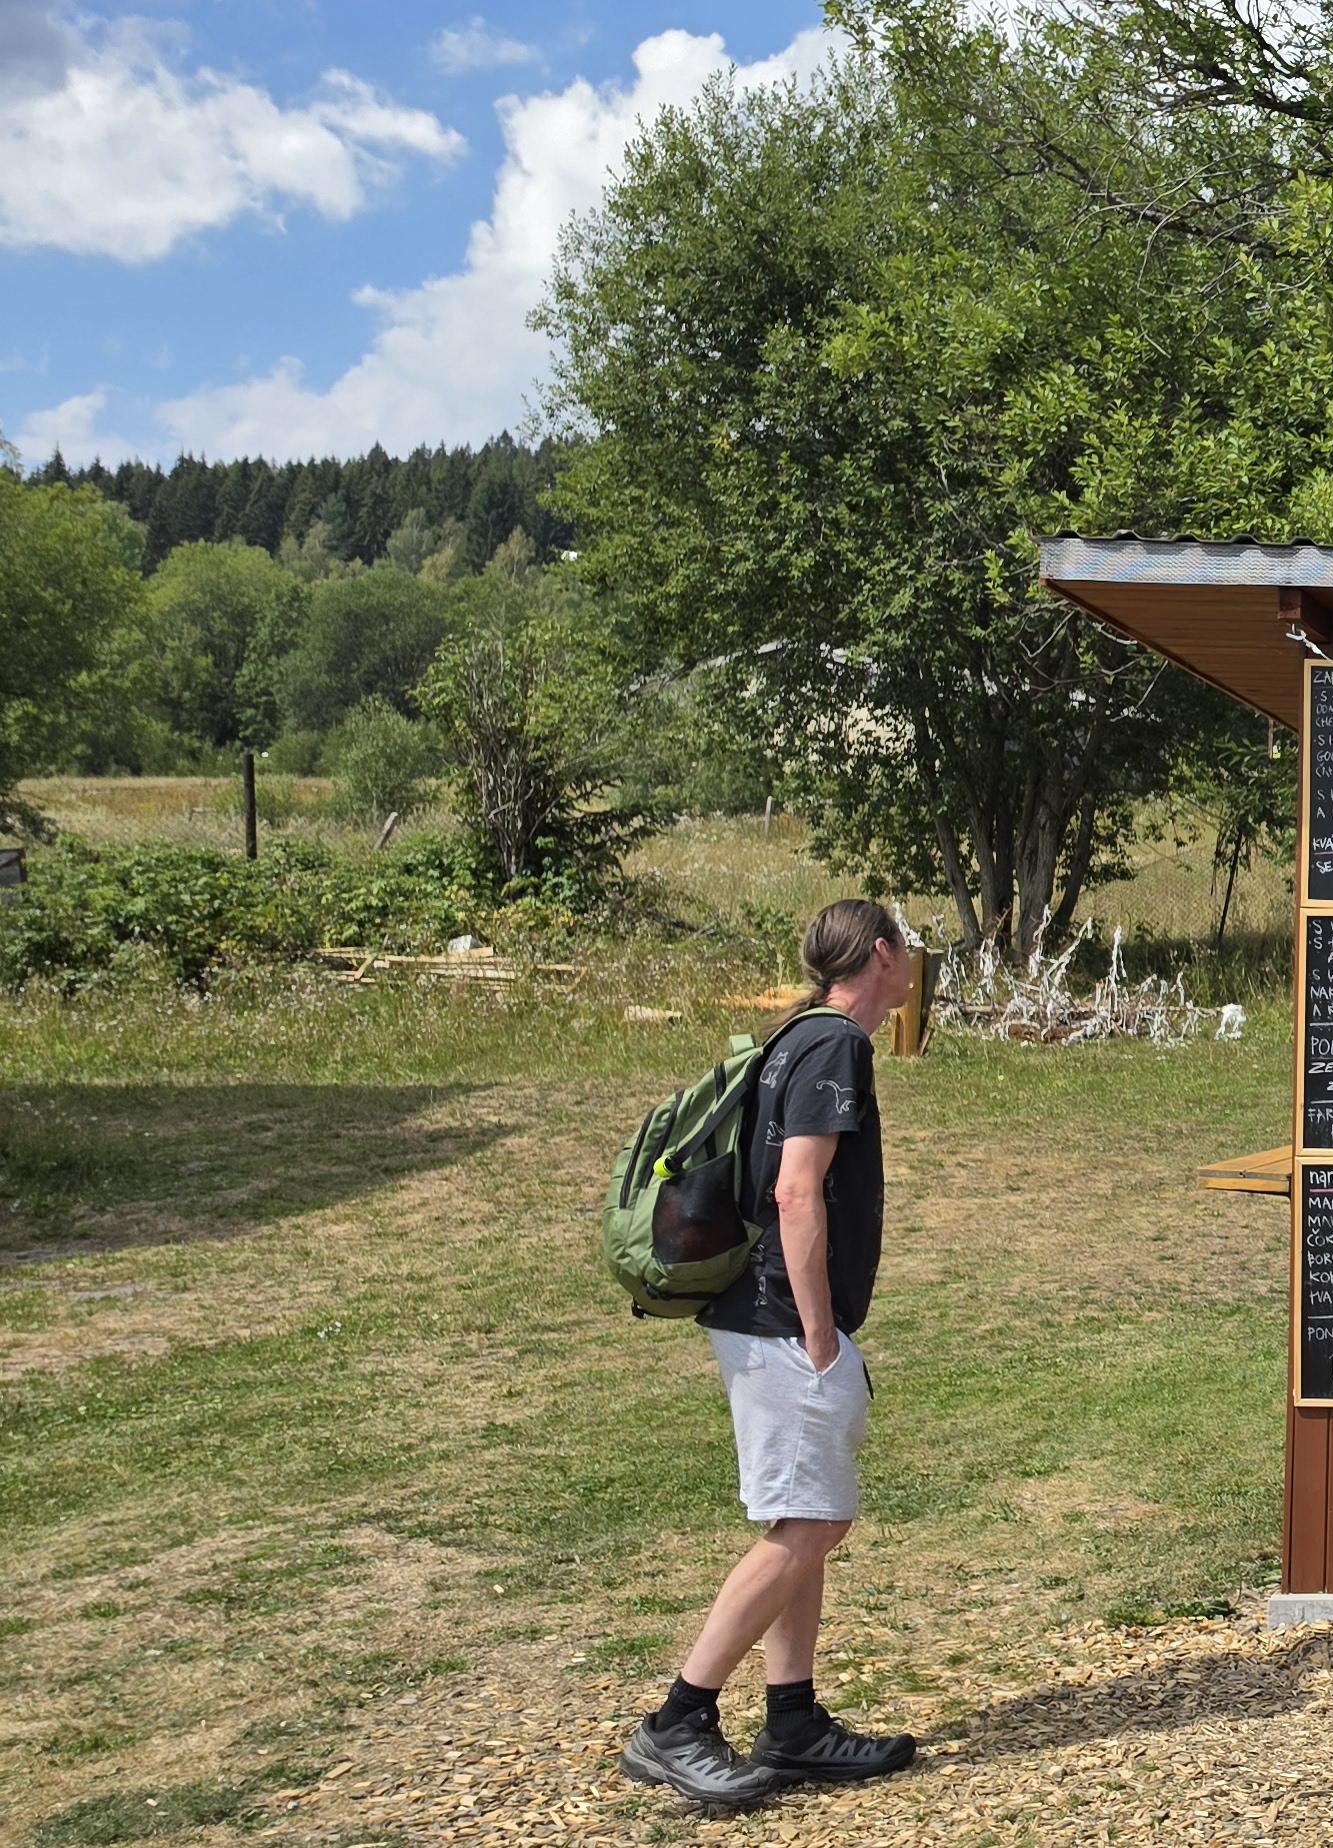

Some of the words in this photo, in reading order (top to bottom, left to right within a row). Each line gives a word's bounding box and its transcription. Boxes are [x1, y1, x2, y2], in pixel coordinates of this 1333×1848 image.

[1321, 691, 1327, 701] S
[1318, 734, 1325, 745] S
[1318, 790, 1325, 800] S
[1317, 808, 1325, 819] A
[1316, 861, 1333, 873] SE
[1313, 920, 1323, 934] S
[1314, 937, 1323, 949] S
[1312, 969, 1320, 981] S
[1312, 1005, 1321, 1017] A
